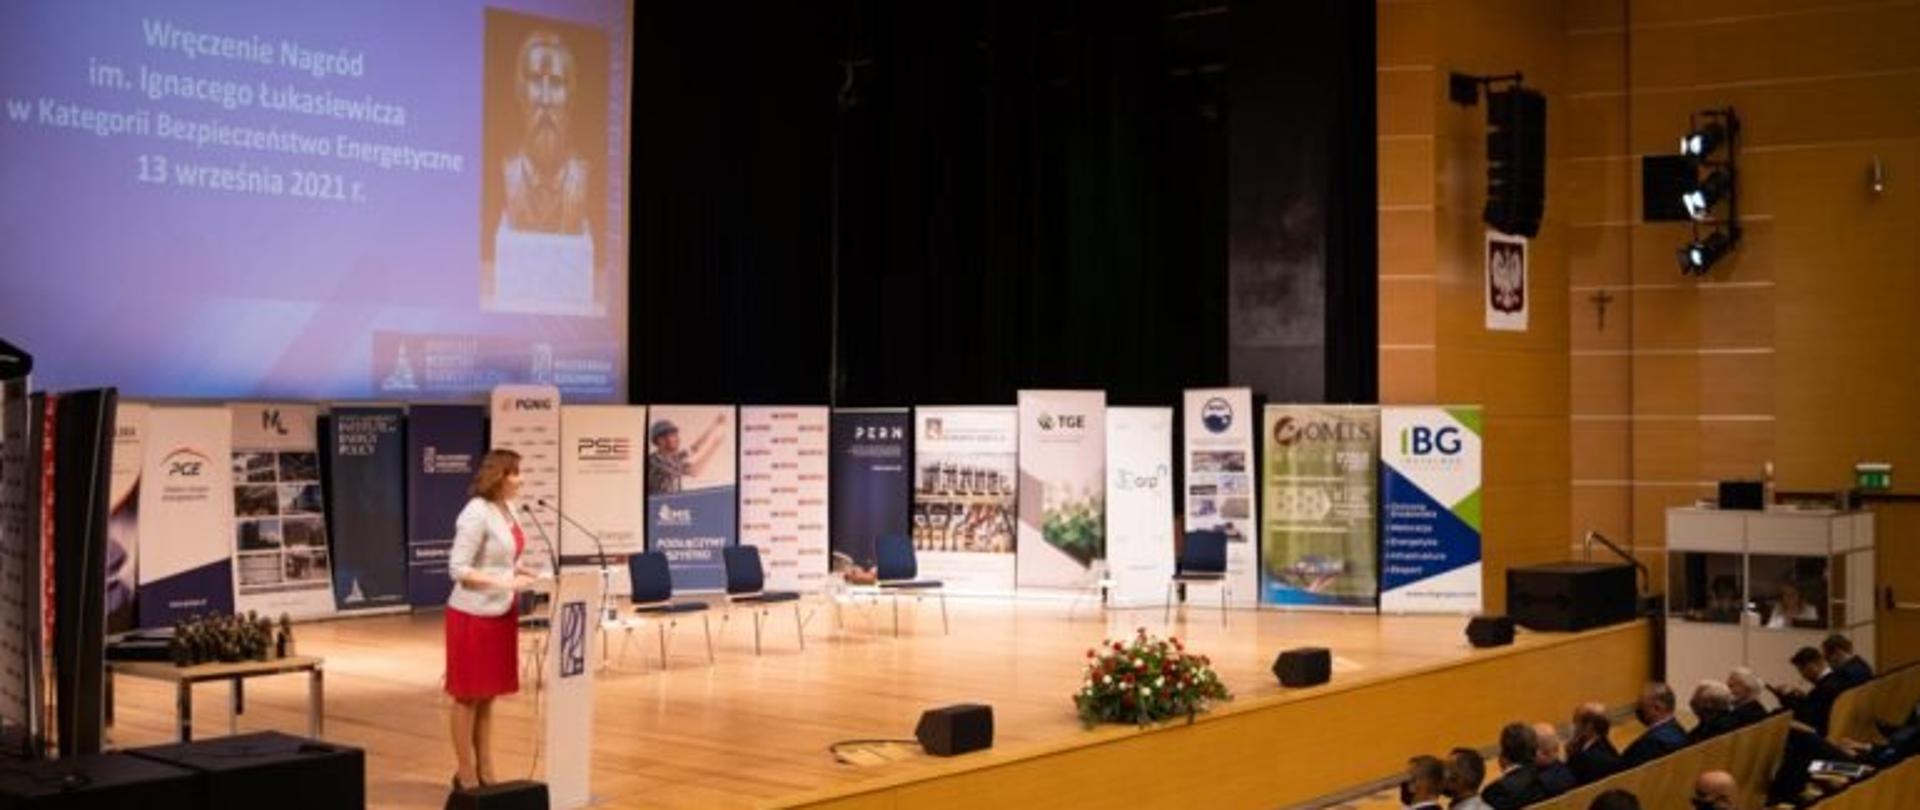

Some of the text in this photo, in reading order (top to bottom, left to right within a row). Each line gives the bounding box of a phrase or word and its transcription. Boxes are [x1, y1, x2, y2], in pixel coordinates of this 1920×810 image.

[142, 18, 364, 78] Wręczenie Nagród
[89, 56, 405, 126] im. Ignacego Łukasiewicza
[6, 98, 464, 172] w Kategorii Bezpieczeństwo Energetyczne
[138, 154, 367, 203] 13 września 2021 r.
[855, 426, 903, 440] PERN
[1057, 414, 1086, 429] TGE
[578, 438, 631, 453] PSE
[1401, 426, 1462, 456] IBG
[169, 461, 202, 476] PGE
